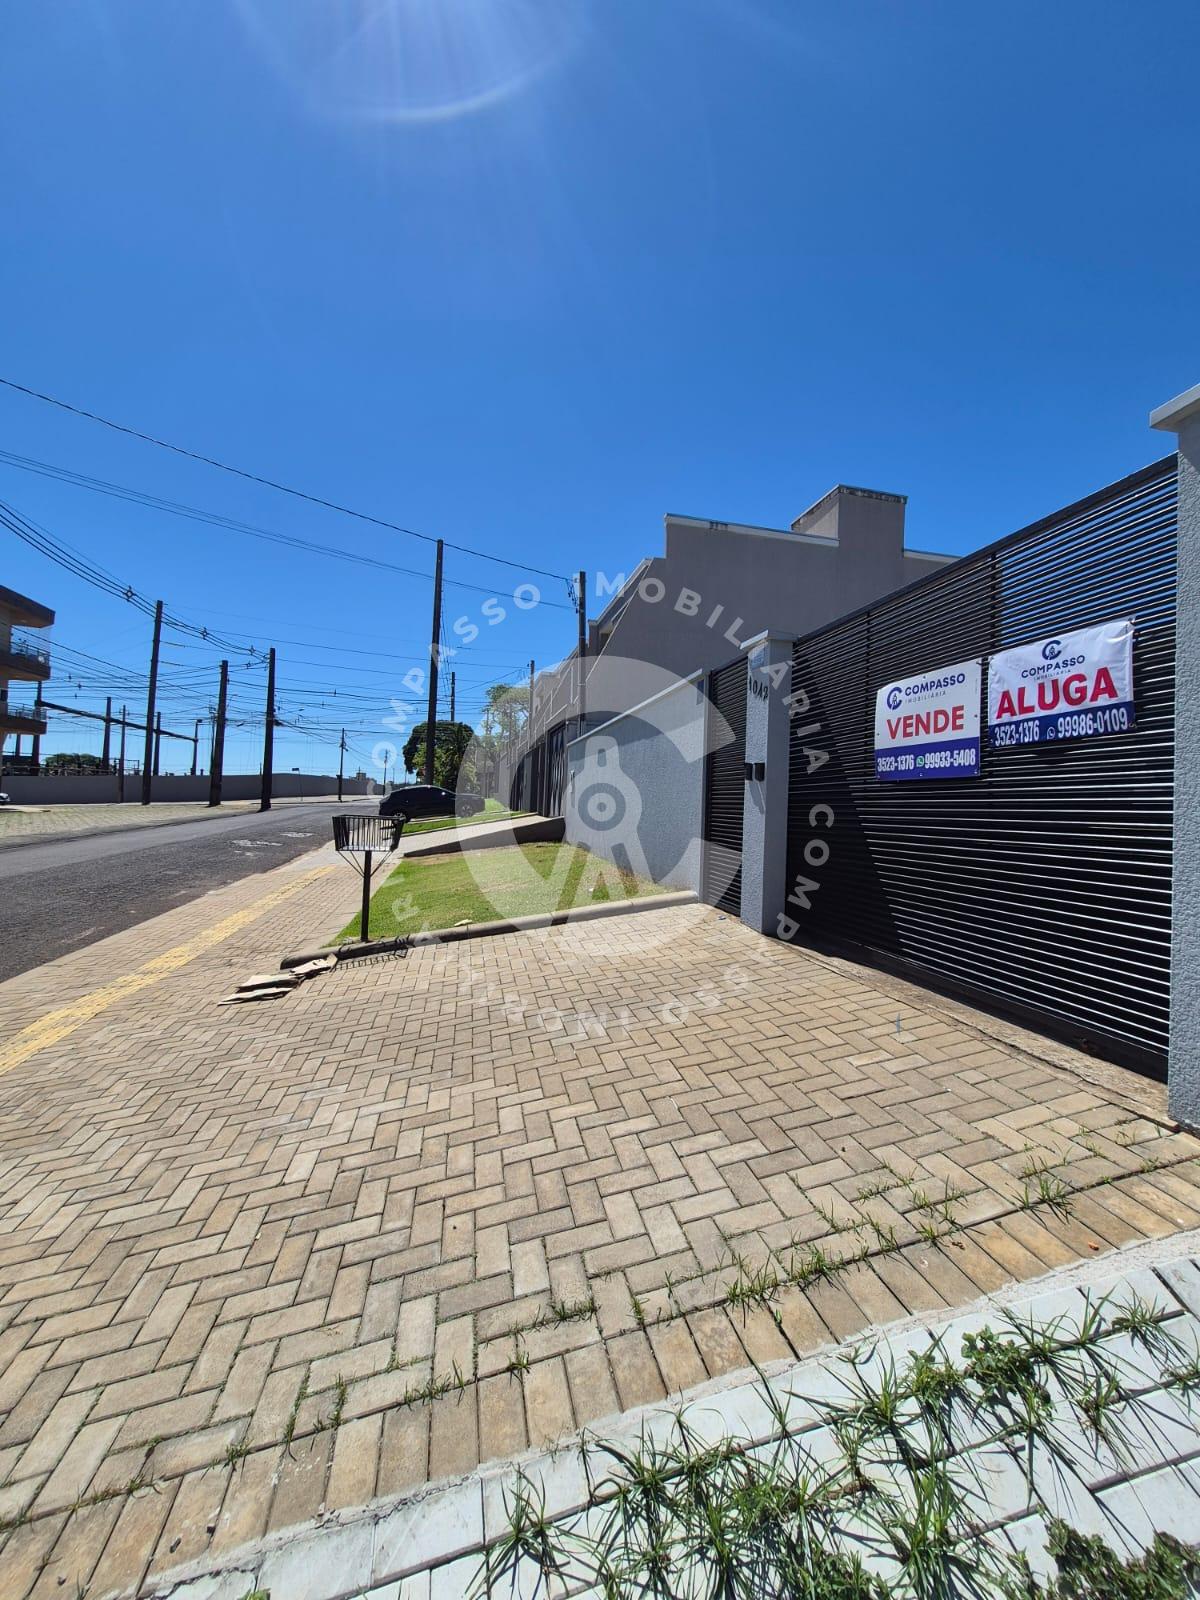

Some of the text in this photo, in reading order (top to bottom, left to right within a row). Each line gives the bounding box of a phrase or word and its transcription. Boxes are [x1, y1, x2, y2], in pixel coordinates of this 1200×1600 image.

[1021, 654, 1085, 679] COMPASSO
[904, 673, 966, 697] COMPASSO
[995, 666, 1119, 720] ALUGA
[886, 705, 965, 740] VENDE
[994, 707, 1128, 747] 3523-1376 99986-0109
[877, 748, 976, 772] 3523-1376 99933-5408
